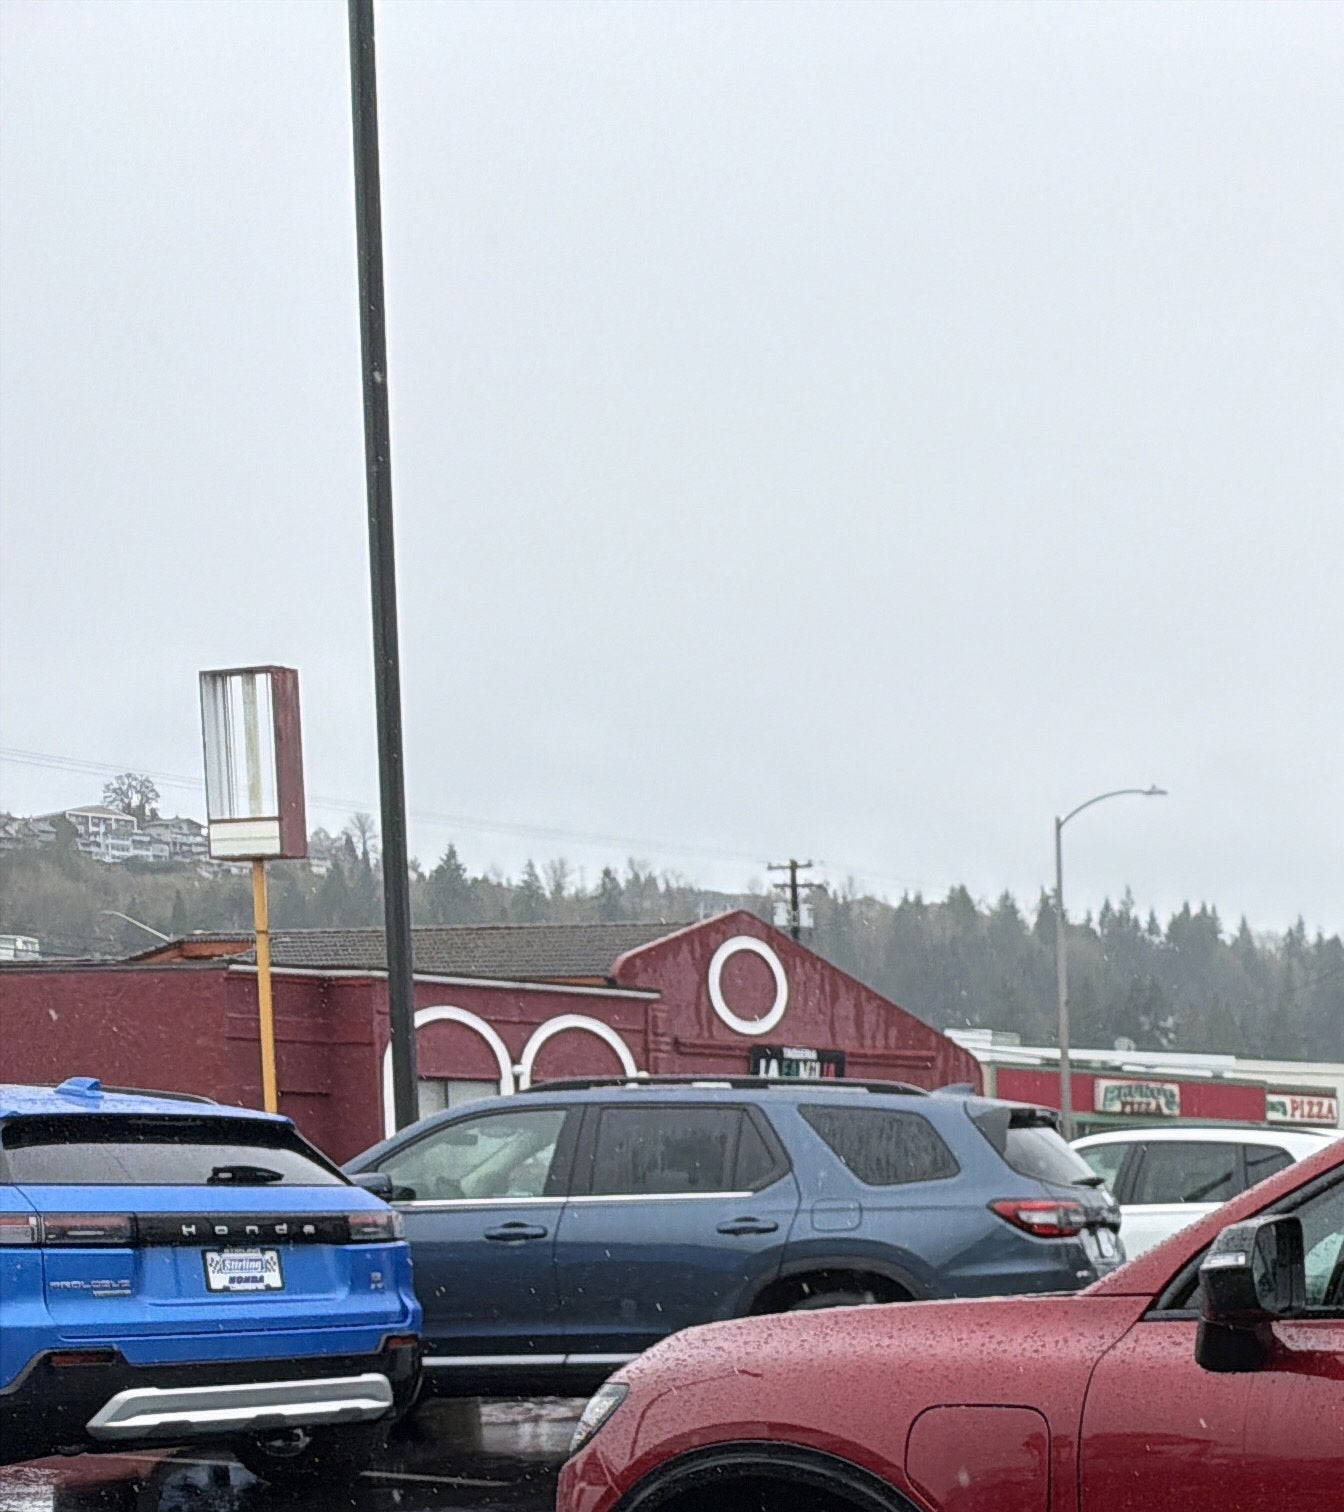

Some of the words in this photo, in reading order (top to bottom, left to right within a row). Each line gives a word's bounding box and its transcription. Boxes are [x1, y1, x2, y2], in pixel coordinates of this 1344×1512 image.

[1121, 1101, 1164, 1116] PIZZA
[1290, 1099, 1336, 1120] PIZZA
[224, 1259, 263, 1272] Stirling
[228, 1275, 265, 1285] HONDA
